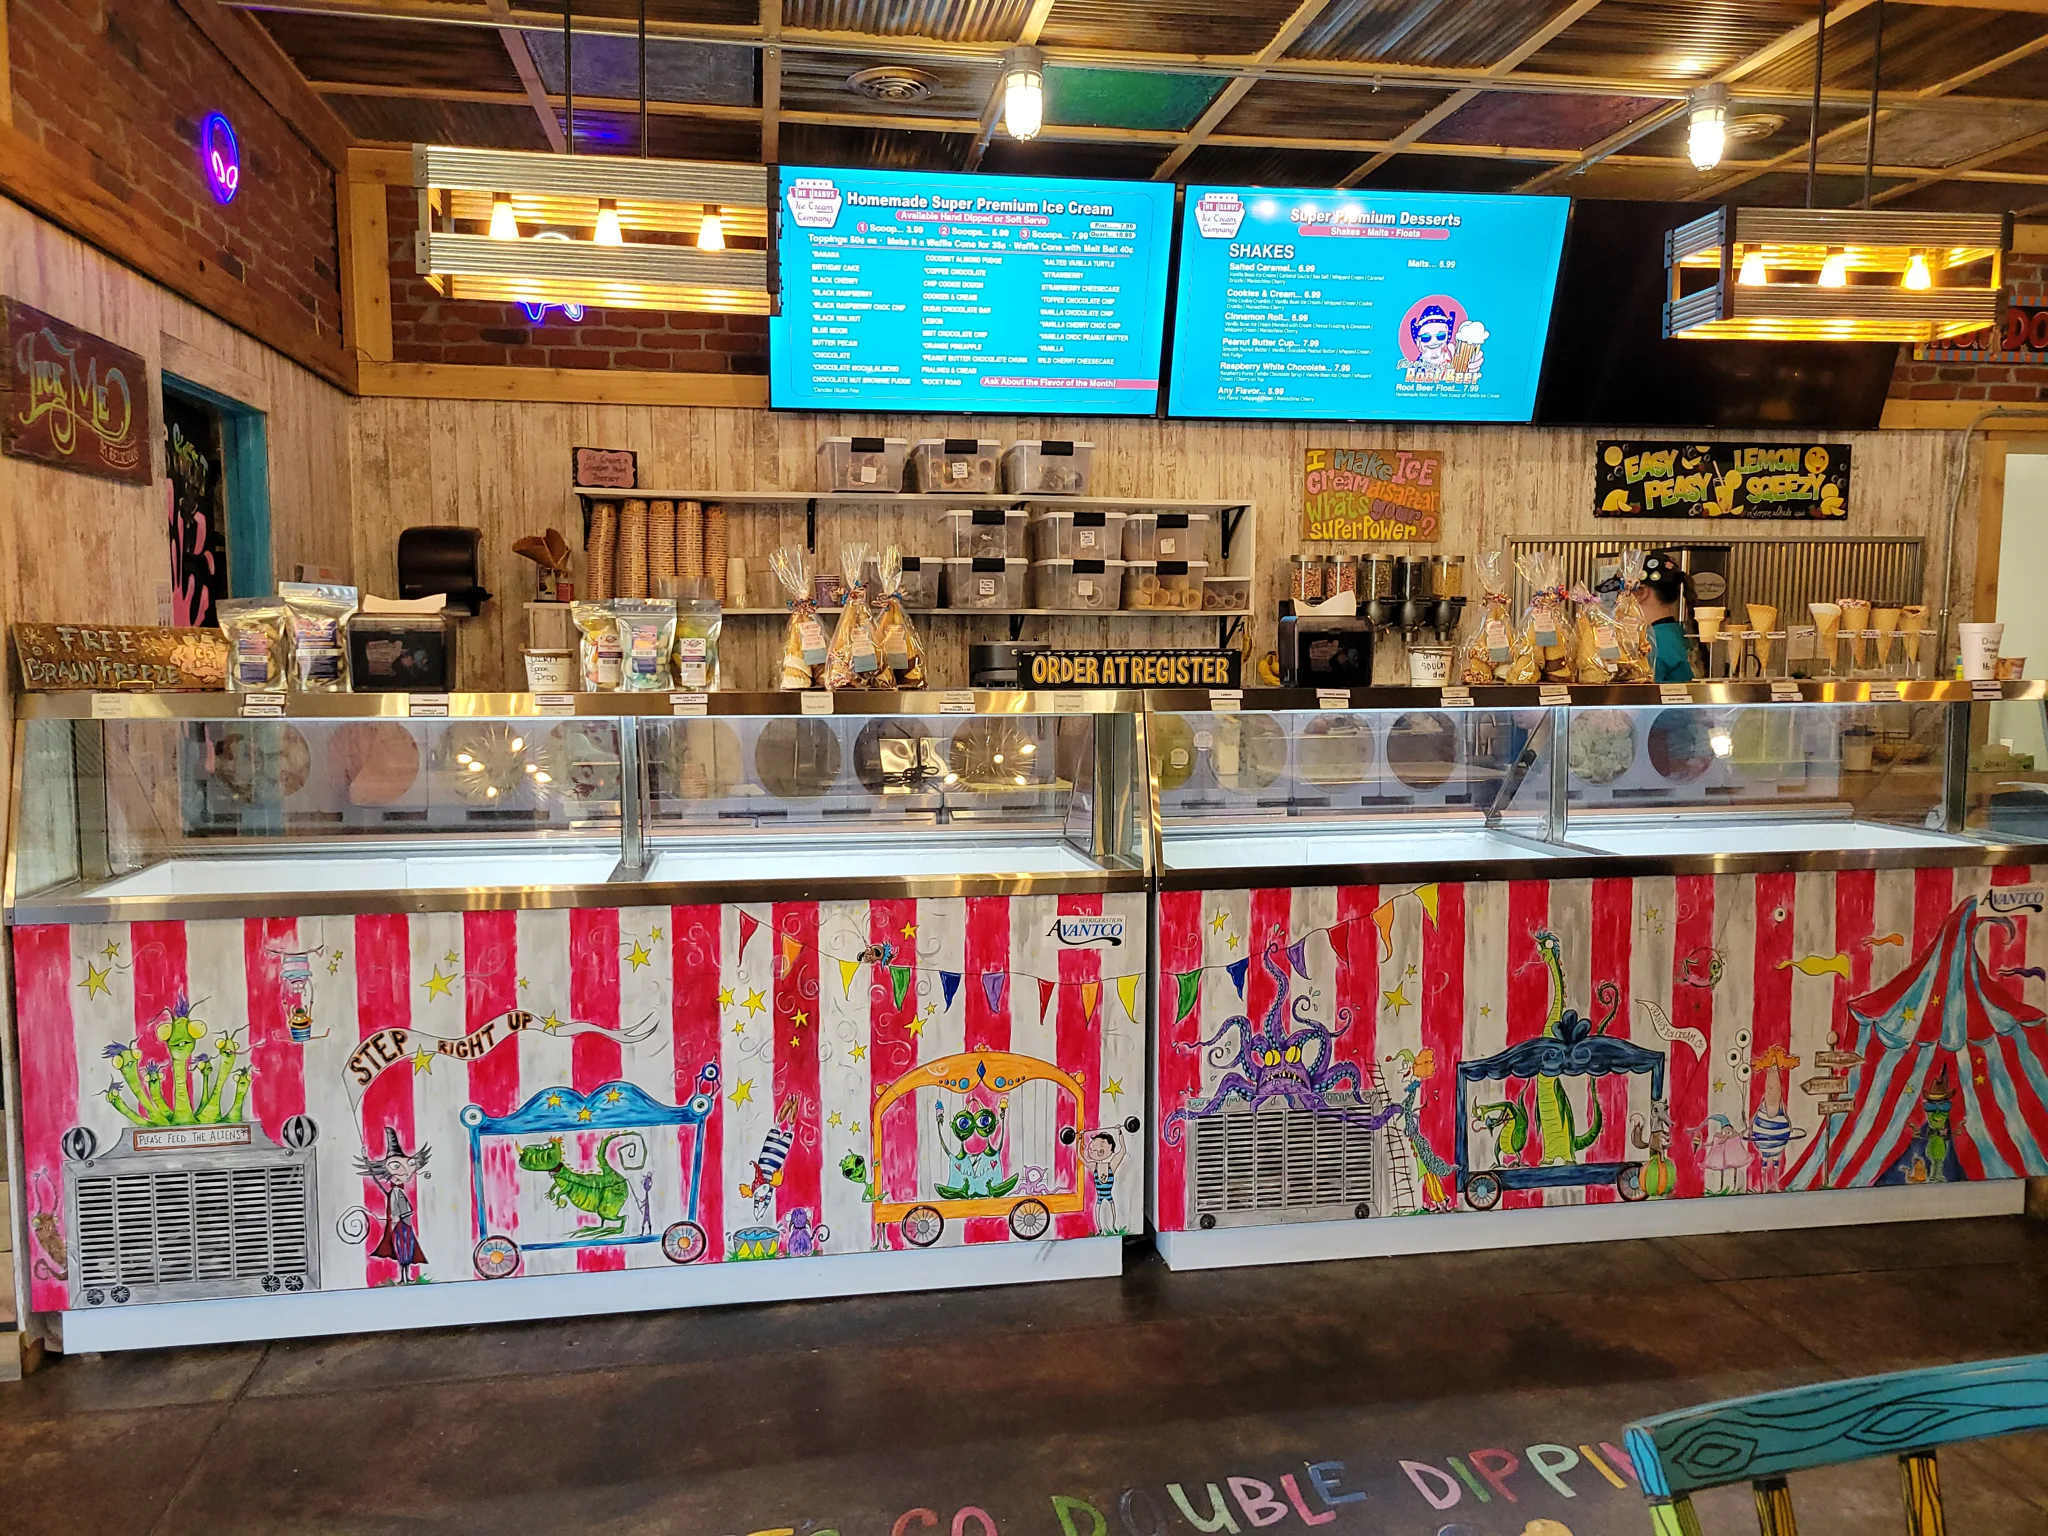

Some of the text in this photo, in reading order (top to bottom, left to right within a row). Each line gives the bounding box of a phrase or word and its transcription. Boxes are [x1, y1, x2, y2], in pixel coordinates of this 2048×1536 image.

[847, 191, 1113, 216] Homemade Super Premium Ice Cream
[1290, 208, 1332, 225] Super
[1400, 211, 1461, 226] Desserts
[1331, 227, 1420, 237] Shakes Malts Floats
[808, 234, 848, 245] Toppings
[954, 239, 976, 248] Cone
[1041, 242, 1062, 251] Cone
[1064, 244, 1081, 252] with
[1229, 243, 1294, 259] SHAKES
[1229, 262, 1255, 271] Salted
[1227, 289, 1259, 298] Cookies
[1225, 312, 1265, 321] Cinnamon
[1222, 338, 1250, 346] Peanut
[1252, 338, 1275, 346] Butter
[1220, 362, 1260, 372] Raspberry
[1263, 363, 1284, 371] White
[984, 377, 1000, 385] Ask
[1001, 377, 1024, 386] About
[1026, 378, 1039, 386] the
[1218, 387, 1233, 395] Any
[1307, 450, 1325, 472] I
[1334, 449, 1393, 481] Make
[1624, 448, 1801, 484] EASY LEMON
[1644, 473, 1713, 510] PEASY
[56, 626, 136, 653] FREE
[26, 656, 181, 684] BRAIN FREEZE
[1032, 655, 1230, 684] ORDER AT REGISTER
[1980, 889, 2044, 908] AVANTCO
[1046, 919, 1123, 942] AVANTCO
[350, 1012, 534, 1086] STEP RIGHT UP
[138, 1134, 162, 1145] PLEASE
[167, 1133, 186, 1143] FEED
[192, 1132, 206, 1142] THE
[1051, 1460, 1368, 1536] DOUBLE
